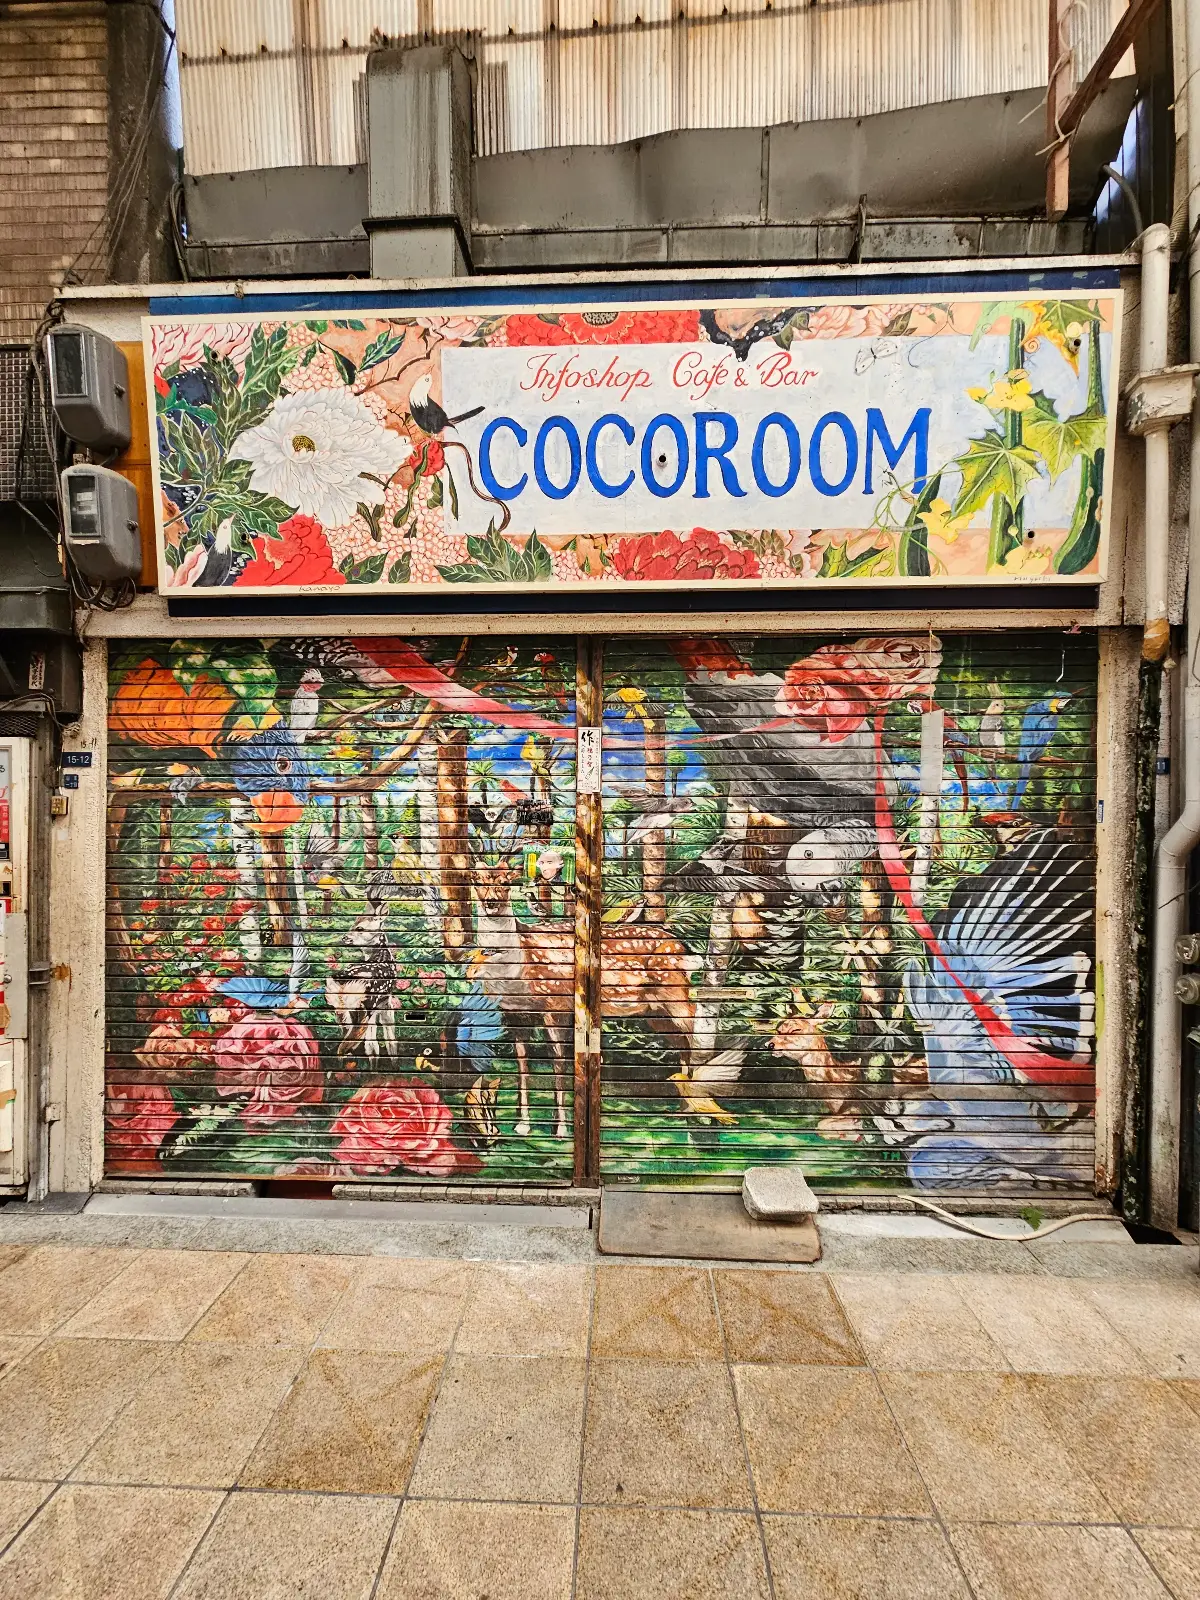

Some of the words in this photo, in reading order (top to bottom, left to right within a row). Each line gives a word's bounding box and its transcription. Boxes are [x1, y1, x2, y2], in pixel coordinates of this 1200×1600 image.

[520, 352, 653, 402] Infoshop
[734, 367, 749, 386] &
[756, 351, 820, 387] Bar
[478, 407, 932, 500] COCOROOM
[67, 755, 90, 764] 15-12
